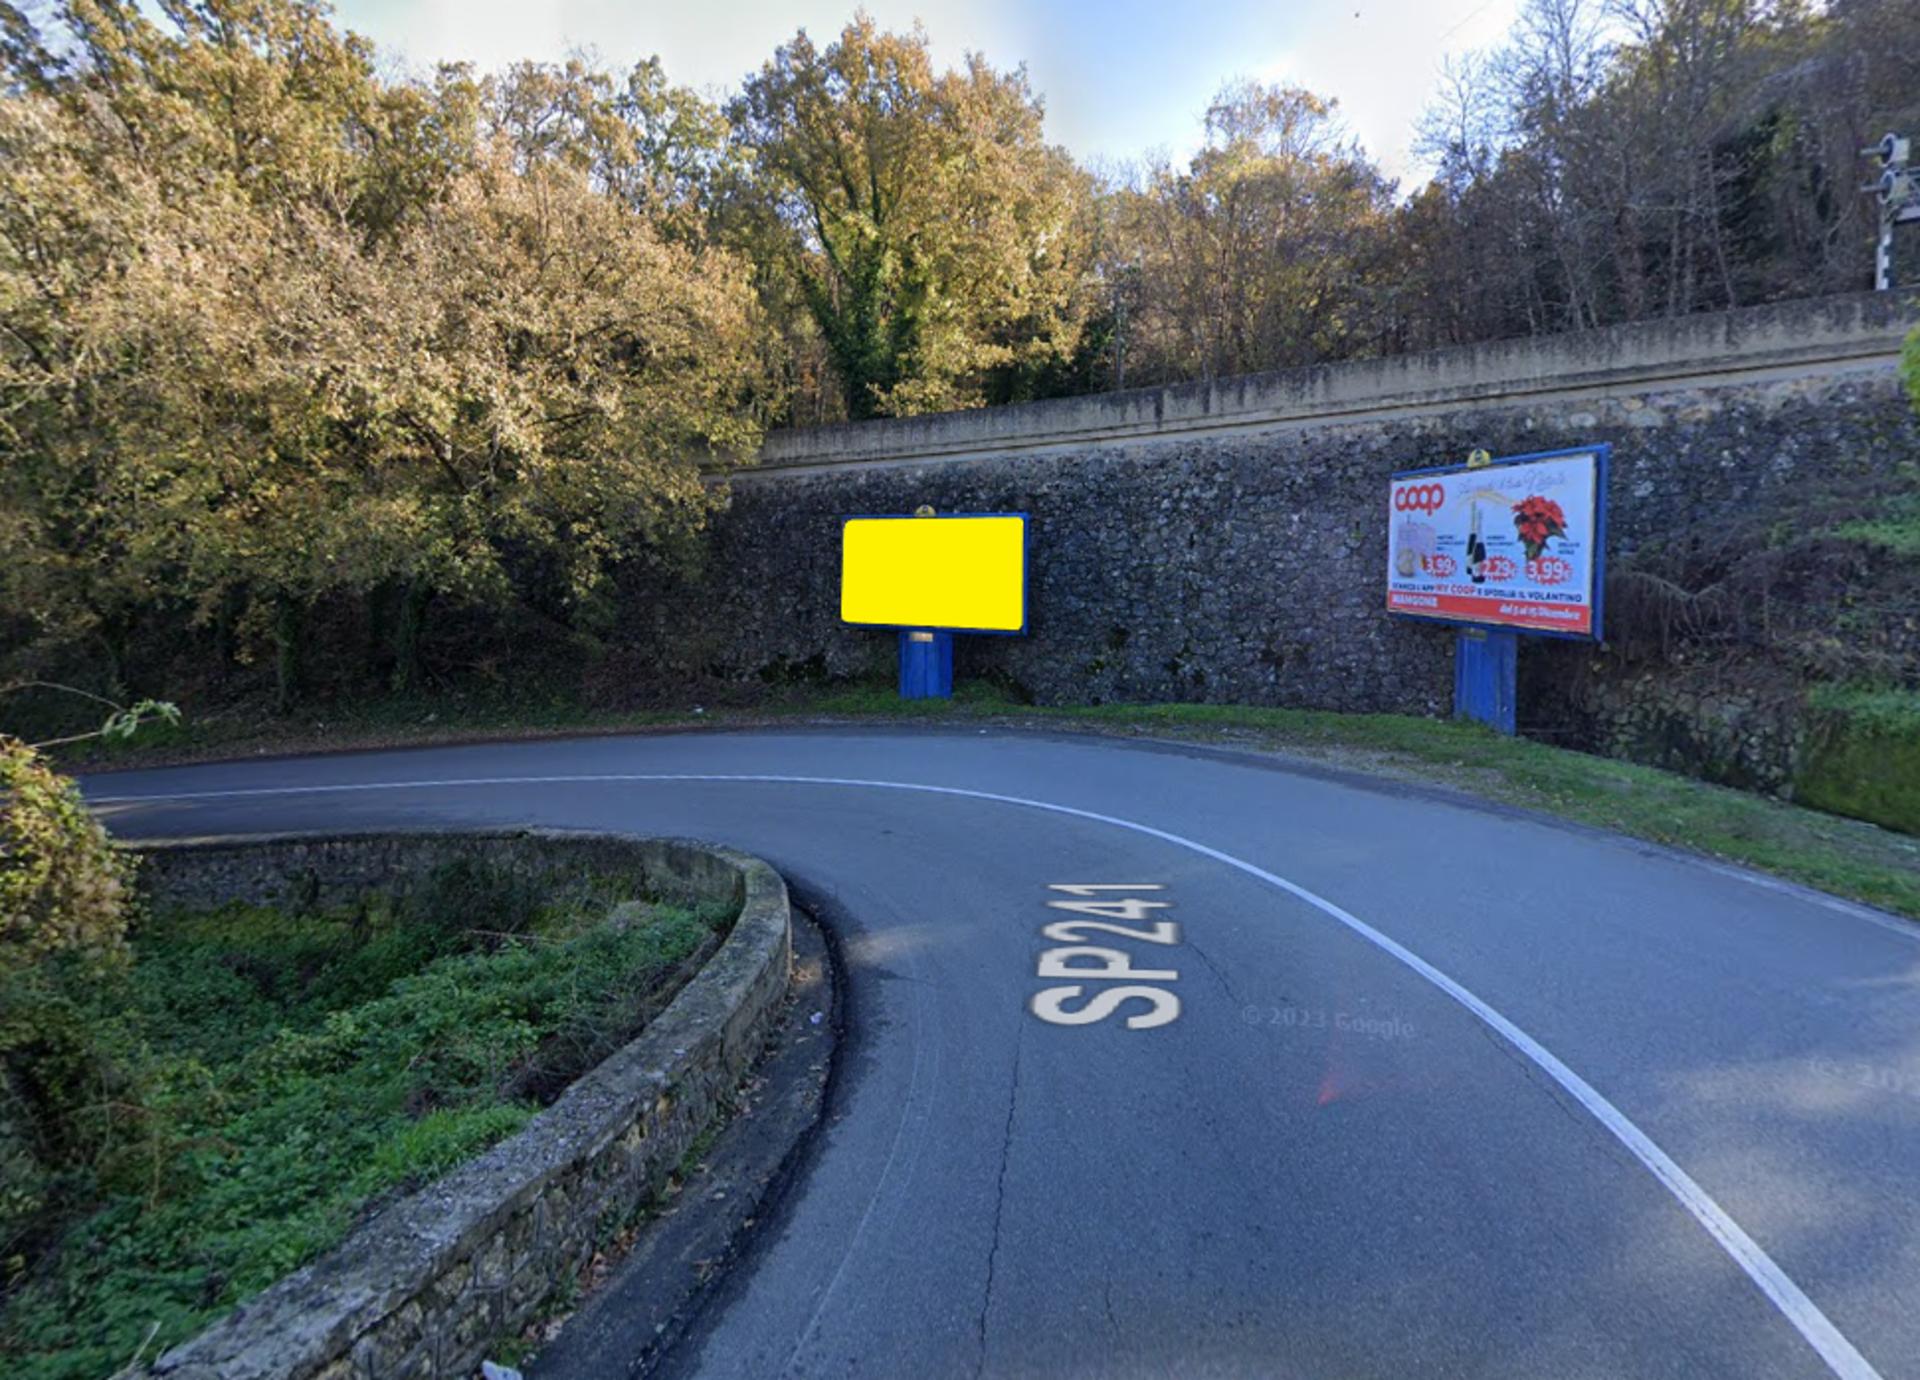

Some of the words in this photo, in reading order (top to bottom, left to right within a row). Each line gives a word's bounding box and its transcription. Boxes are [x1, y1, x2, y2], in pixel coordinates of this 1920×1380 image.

[1395, 483, 1445, 517] coop
[1450, 584, 1476, 595] COOP
[1527, 590, 1582, 603] VOLANTINO
